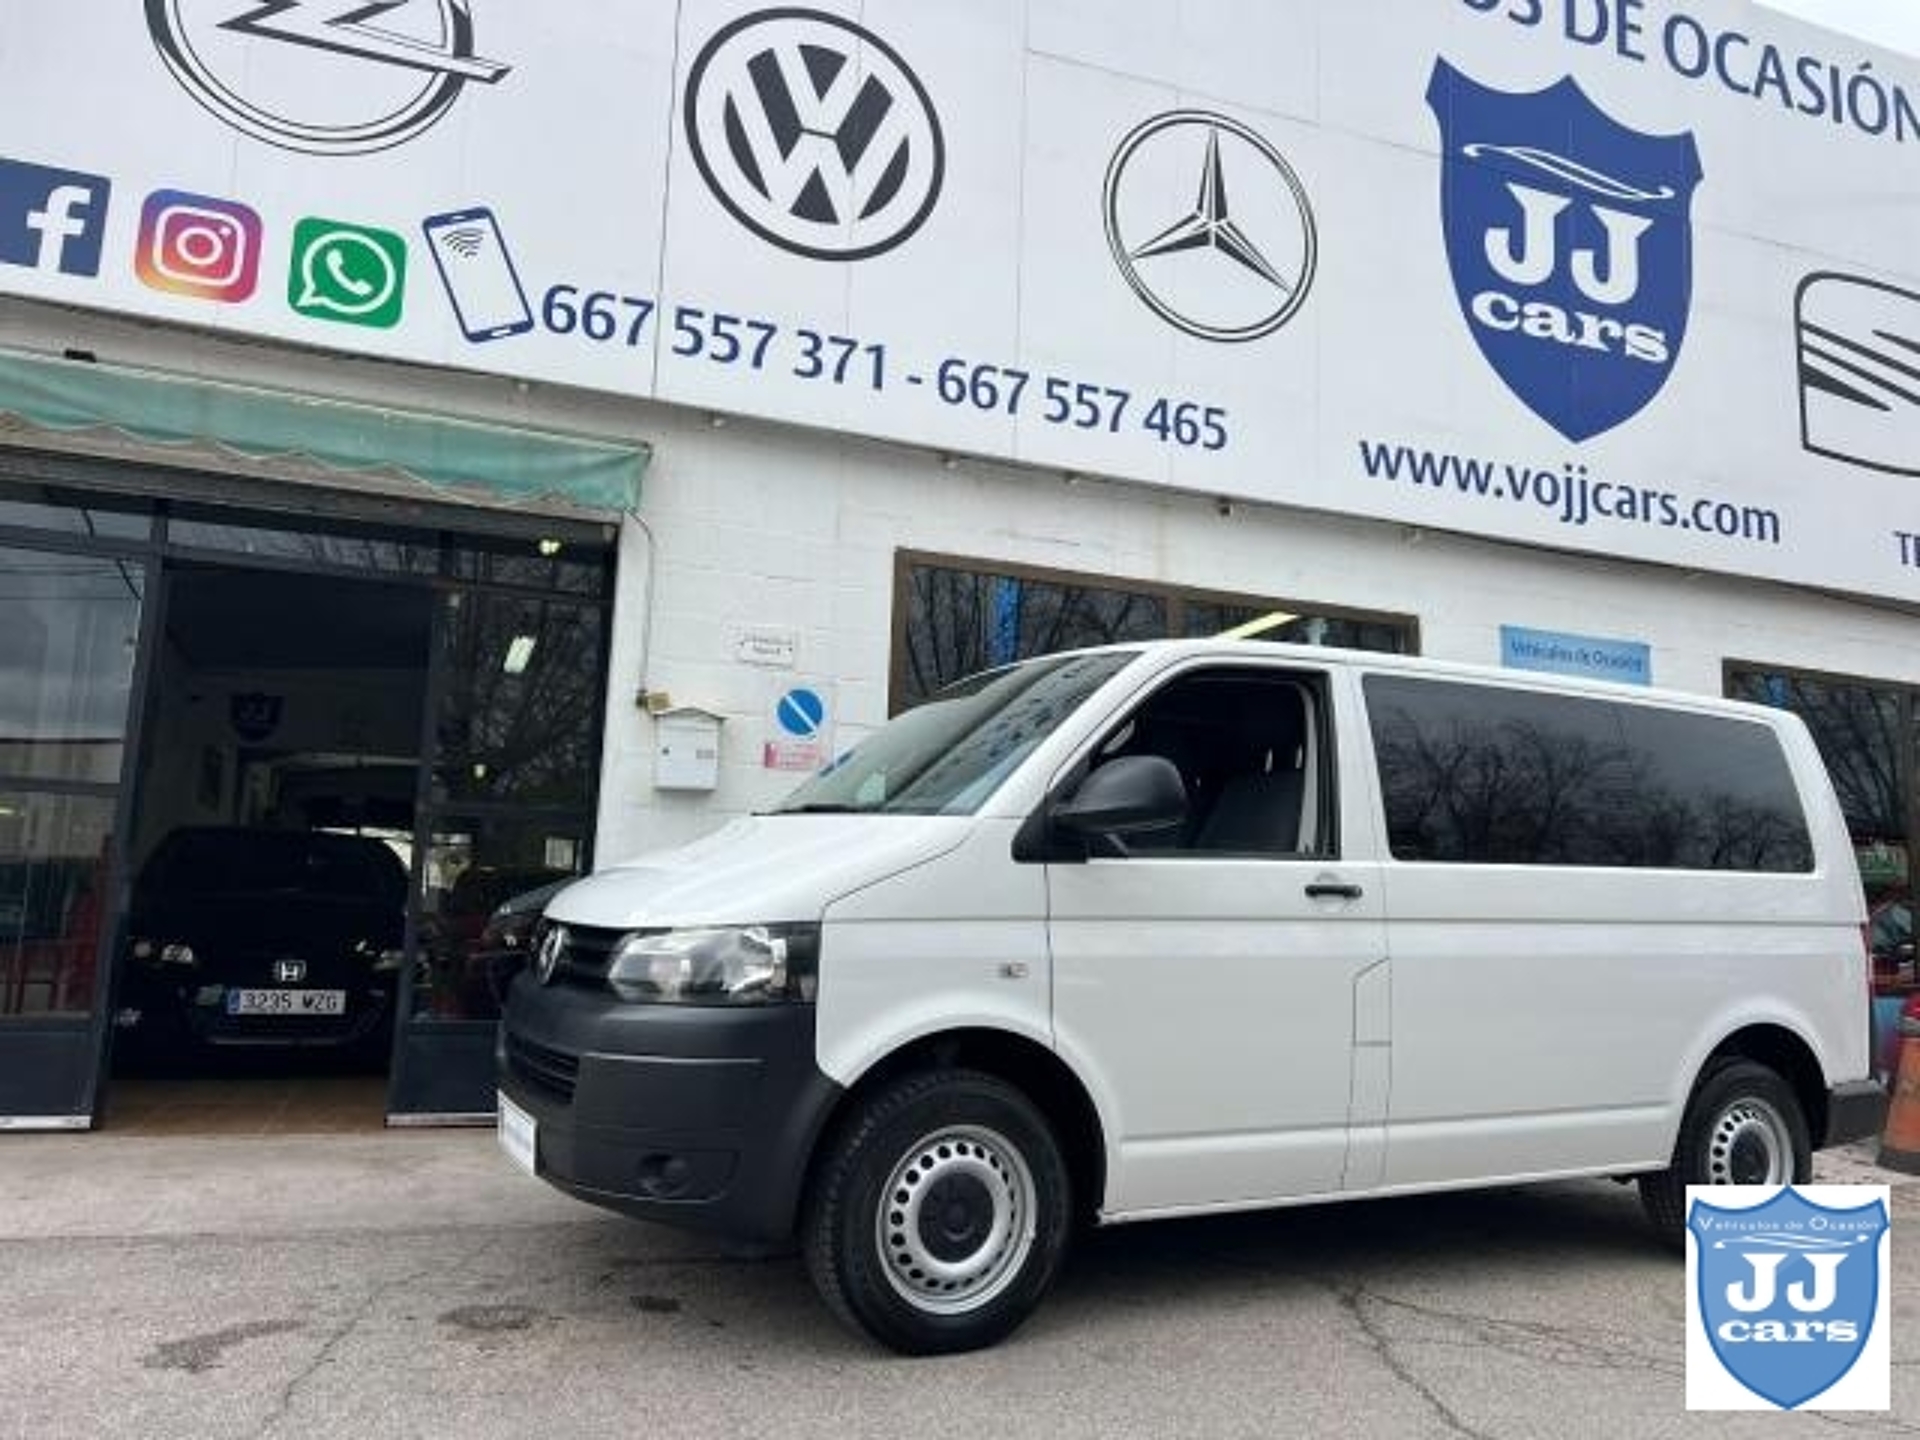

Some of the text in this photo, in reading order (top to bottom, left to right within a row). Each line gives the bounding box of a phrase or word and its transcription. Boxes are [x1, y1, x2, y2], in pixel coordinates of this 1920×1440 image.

[1565, 0, 1645, 61] DE
[1664, 14, 1920, 141] OCASIÓN
[1484, 182, 1653, 303] JJ
[541, 284, 654, 347] 667
[672, 306, 778, 370] 557
[793, 329, 888, 390] 371
[937, 358, 1028, 415] 667
[1043, 377, 1130, 433] 557
[1144, 398, 1229, 450] 465
[1471, 290, 1669, 363] cars
[1359, 439, 1781, 543] www.vojjcars.com
